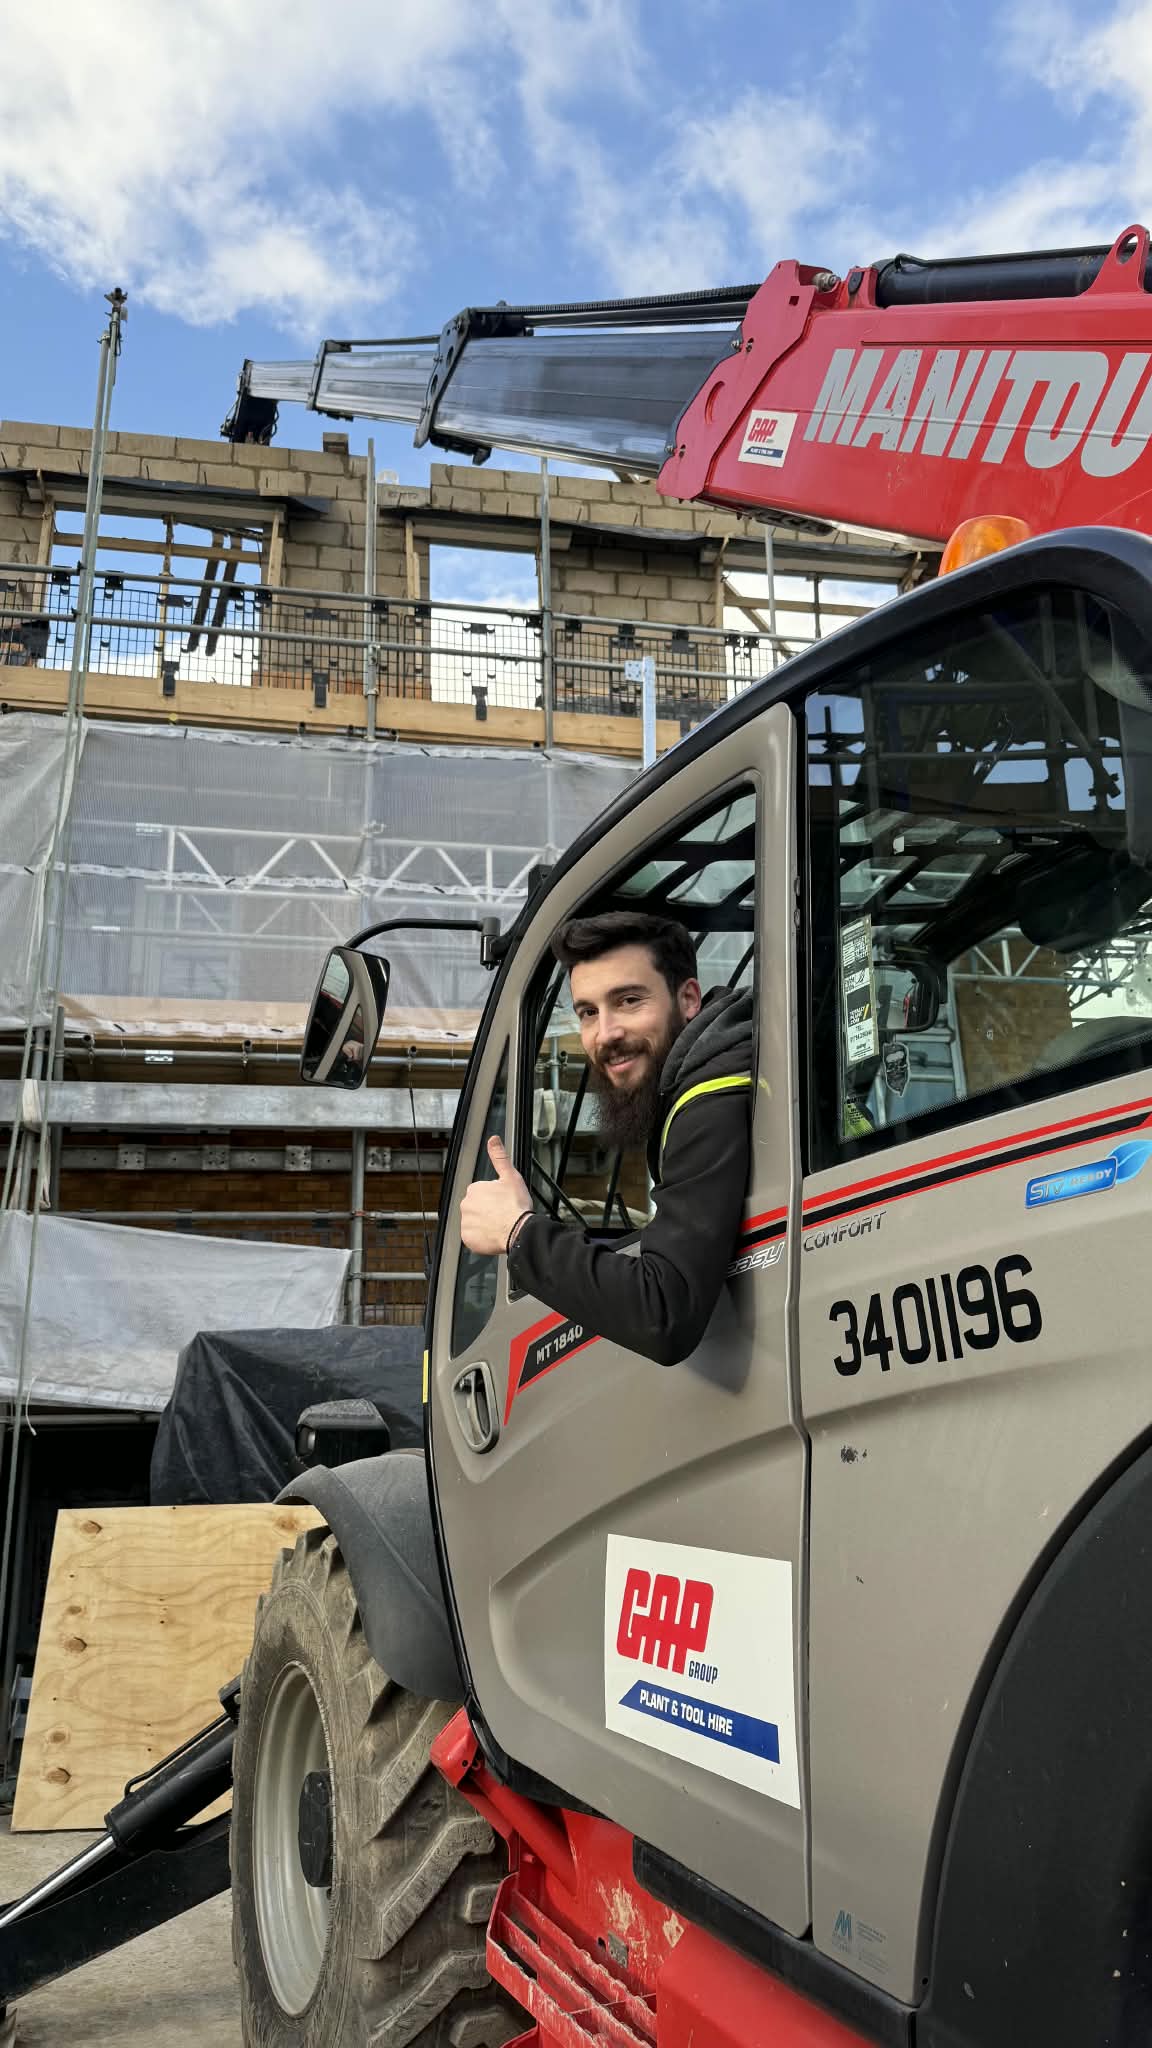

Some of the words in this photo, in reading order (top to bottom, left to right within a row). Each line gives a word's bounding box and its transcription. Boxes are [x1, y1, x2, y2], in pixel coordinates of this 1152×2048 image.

[747, 417, 778, 443] GAP
[828, 1253, 1043, 1377] 3401196
[536, 1343, 552, 1365] MT
[553, 1324, 583, 1352] 1840
[616, 1567, 714, 1675] GAP
[688, 1660, 718, 1684] GROUP
[639, 1689, 670, 1712] PLANT
[671, 1700, 679, 1717] &
[681, 1702, 706, 1727] TOOL
[708, 1713, 733, 1736] HIRE
